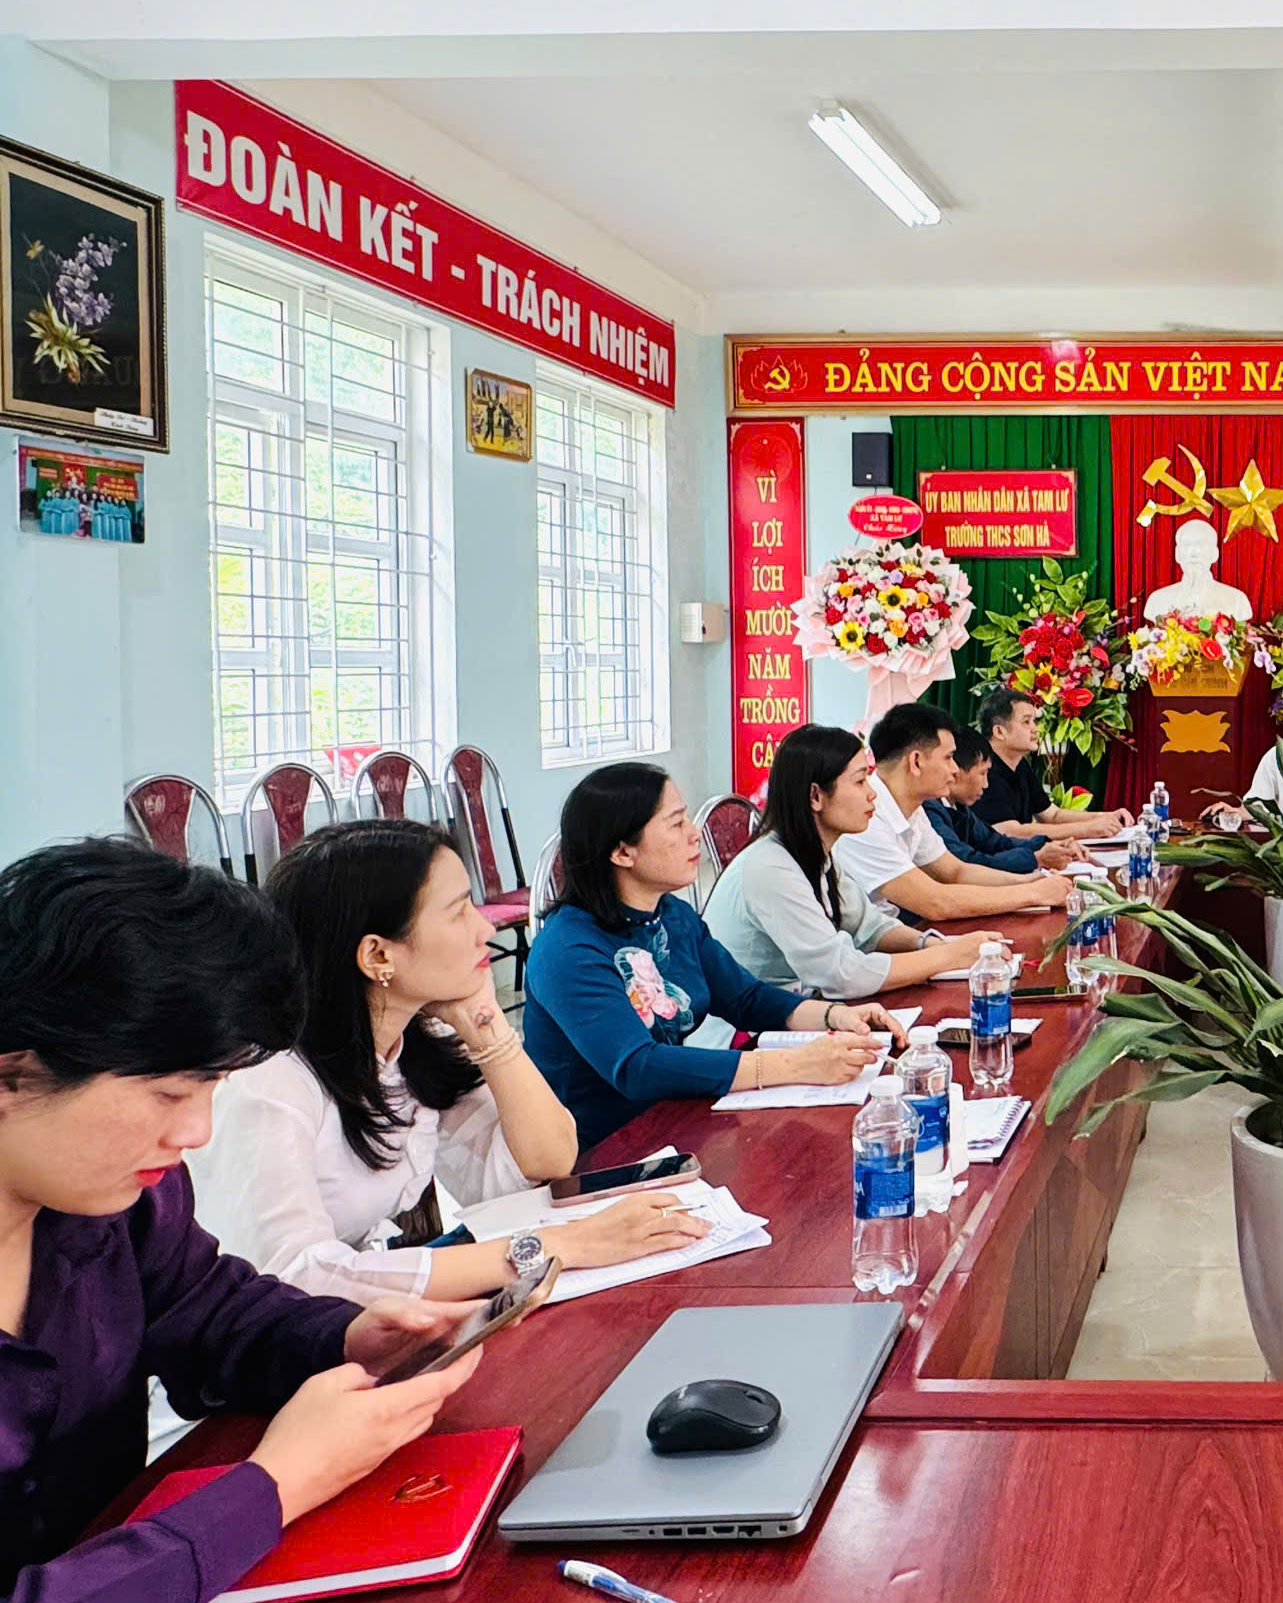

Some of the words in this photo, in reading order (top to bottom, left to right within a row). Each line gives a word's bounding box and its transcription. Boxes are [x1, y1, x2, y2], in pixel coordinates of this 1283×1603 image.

[185, 111, 343, 242] ĐOÀN
[359, 196, 439, 282] KẾT
[450, 264, 466, 280] -
[477, 253, 581, 347] TRÁCH
[590, 309, 670, 387] NHIỆM
[825, 348, 932, 393] ĐẢNG
[941, 351, 1046, 400] CỘNG
[1055, 347, 1131, 393] SẢN
[1142, 351, 1231, 400] VIỆT
[757, 469, 777, 503] VÌ
[925, 482, 938, 513] ỦY
[941, 490, 961, 513] BAN
[963, 485, 992, 513] NHÂN
[993, 485, 1015, 513] DÂN
[1016, 485, 1030, 513] XÃ
[1032, 489, 1054, 513] TAM
[1056, 488, 1069, 513] LƯ
[752, 517, 783, 555] LỢI
[945, 519, 984, 547] TRƯỜNG
[986, 524, 1011, 547] THCS
[1013, 523, 1034, 547] SƠN
[1036, 519, 1050, 547] HÀ
[752, 557, 785, 592] ÍCH
[745, 601, 793, 636] MƯỜI
[748, 647, 791, 680] NĂM
[740, 684, 801, 724] TRỒNG
[752, 733, 780, 768] CÂ
